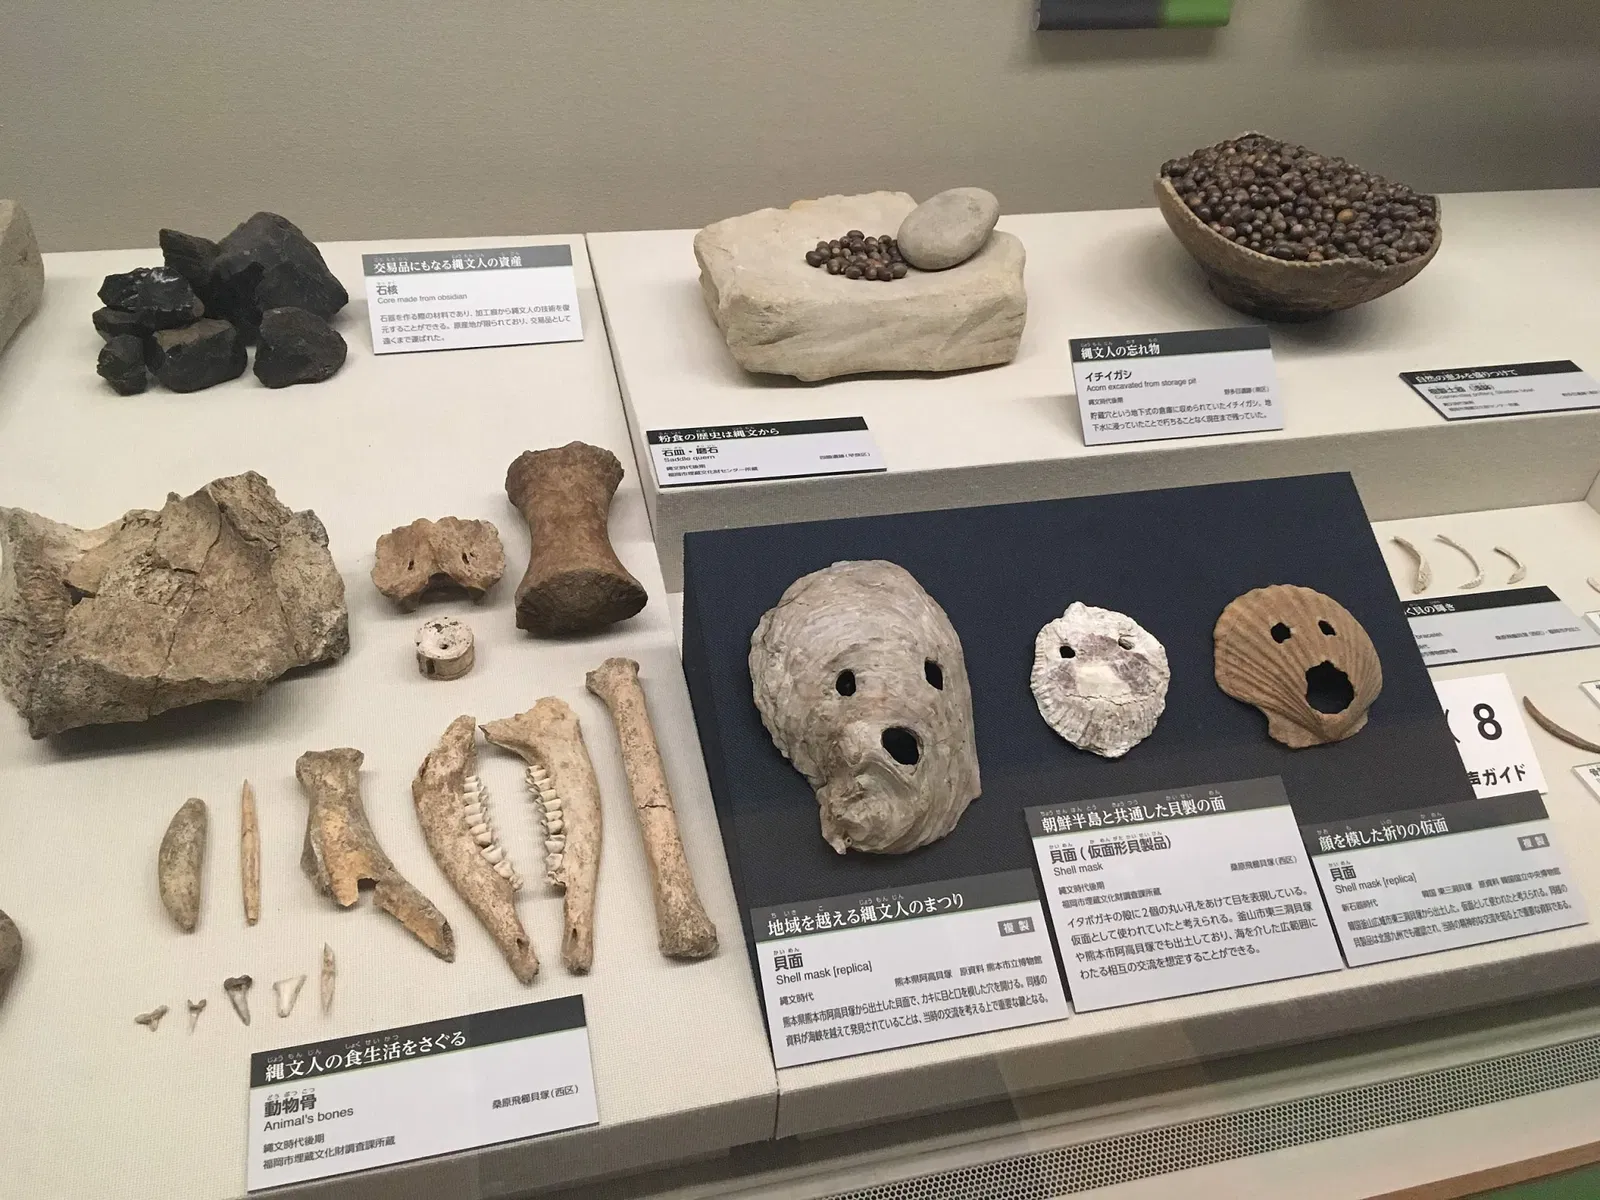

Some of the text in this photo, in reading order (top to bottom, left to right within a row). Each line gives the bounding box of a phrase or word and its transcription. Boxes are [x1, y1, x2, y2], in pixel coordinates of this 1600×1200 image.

[374, 256, 522, 273] 交易品にもなる縄文人の資産
[376, 285, 398, 295] 石核
[377, 293, 468, 304] Core made from obsidian
[1081, 343, 1160, 359] 縄文人の忘れ物
[1085, 370, 1132, 382] イチイガシ
[1108, 382, 1143, 390] excavated
[1161, 379, 1186, 387] storage
[658, 428, 780, 443] 粉食の歴史は縄文から
[1473, 703, 1502, 740] 8
[1041, 796, 1226, 833] 朝鮮半島と共通した貝製の面
[1318, 817, 1449, 851] 顔を模した祈りの仮面
[1053, 863, 1103, 876] Shell mask
[1330, 865, 1356, 882] 貝面
[1058, 881, 1105, 895] 縄文時代後期
[1335, 872, 1417, 894] Shell mask [replica]
[768, 893, 964, 937] 地域を越える縄文人のまつり
[1003, 919, 1030, 934] 複製
[774, 953, 803, 971] 貝面
[959, 964, 985, 976] 原資料
[1080, 944, 1260, 980] わたる相互の交流を想定することができる。
[776, 961, 872, 985] Shell mask [replica]
[779, 992, 814, 1006] 縄文時代
[265, 1031, 466, 1082] 縄文人の食生活をさぐる
[264, 1093, 317, 1118] 動物骨
[263, 1107, 353, 1131] Animal's bones
[263, 1133, 325, 1153] 縄文時代後期
[263, 1136, 395, 1169] 福岡市埋蔵文化財調査課所蔵
